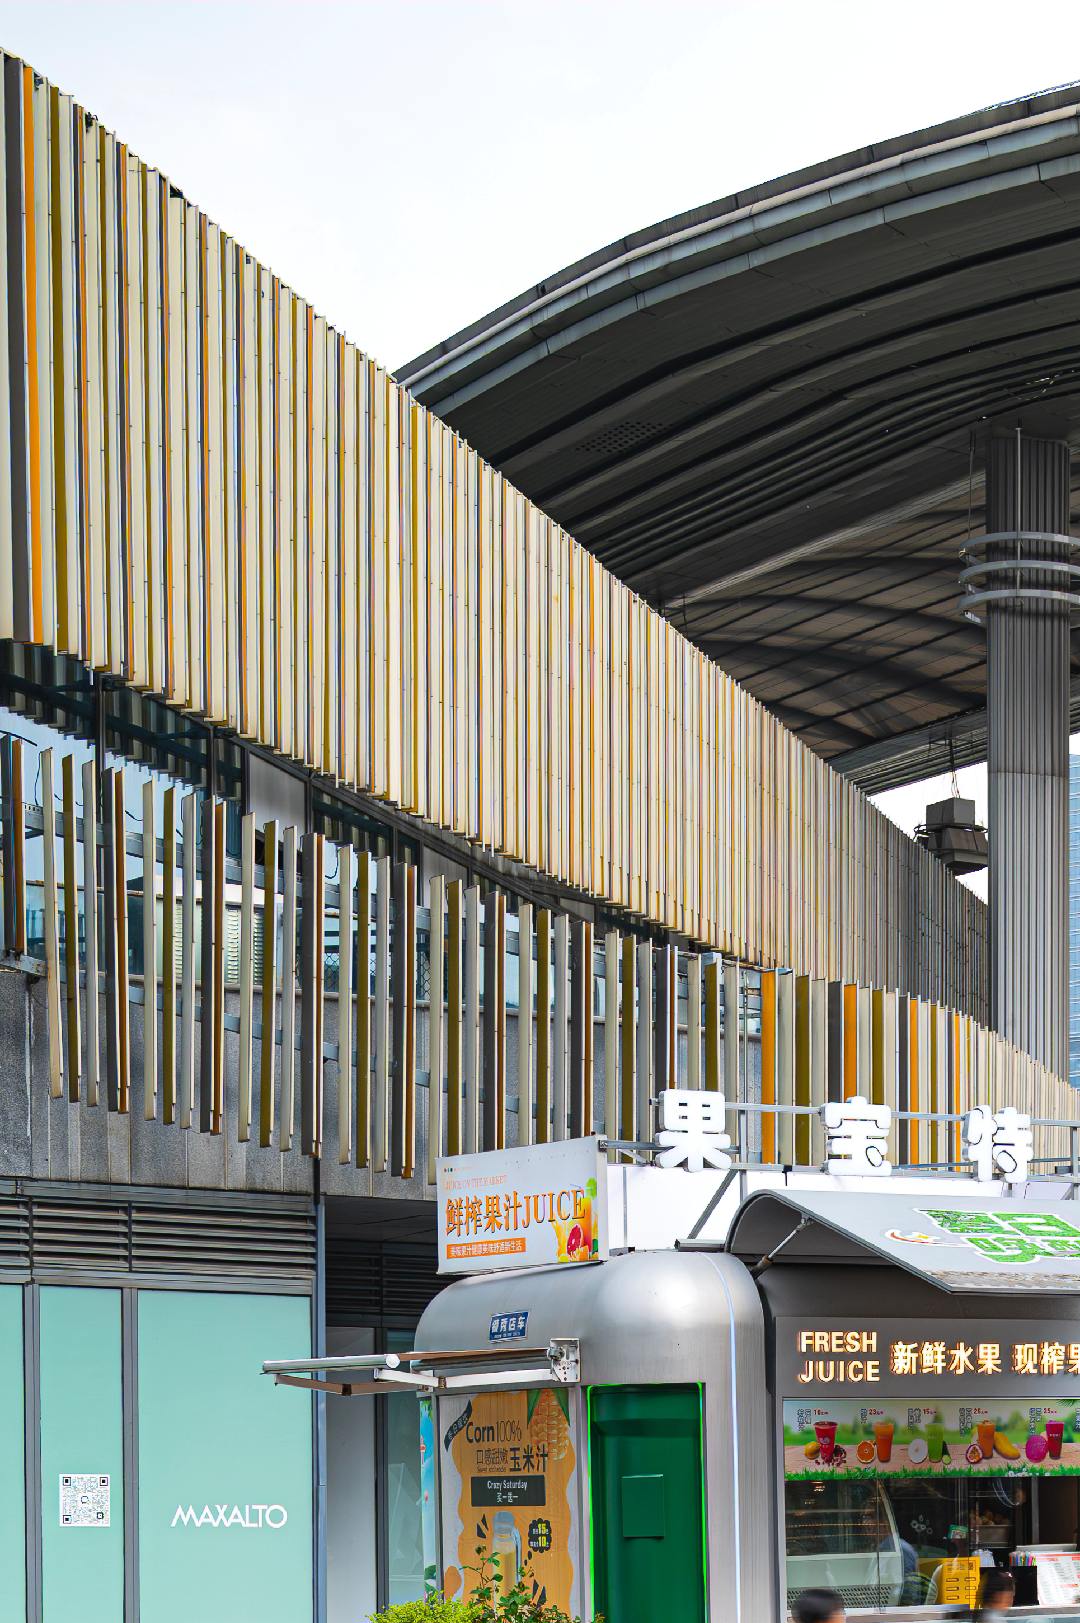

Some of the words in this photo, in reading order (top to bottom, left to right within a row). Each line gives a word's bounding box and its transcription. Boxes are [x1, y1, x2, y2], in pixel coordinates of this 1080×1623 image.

[799, 1331, 877, 1353] FRESH
[892, 1340, 1002, 1375] 新鲜水果
[798, 1360, 880, 1383] JUICE
[466, 1422, 494, 1443] Corn
[509, 1444, 549, 1472] 玉米汁
[487, 1480, 502, 1490] Crazy
[503, 1480, 528, 1491] Saturday
[170, 1504, 288, 1528] MAXALTO
